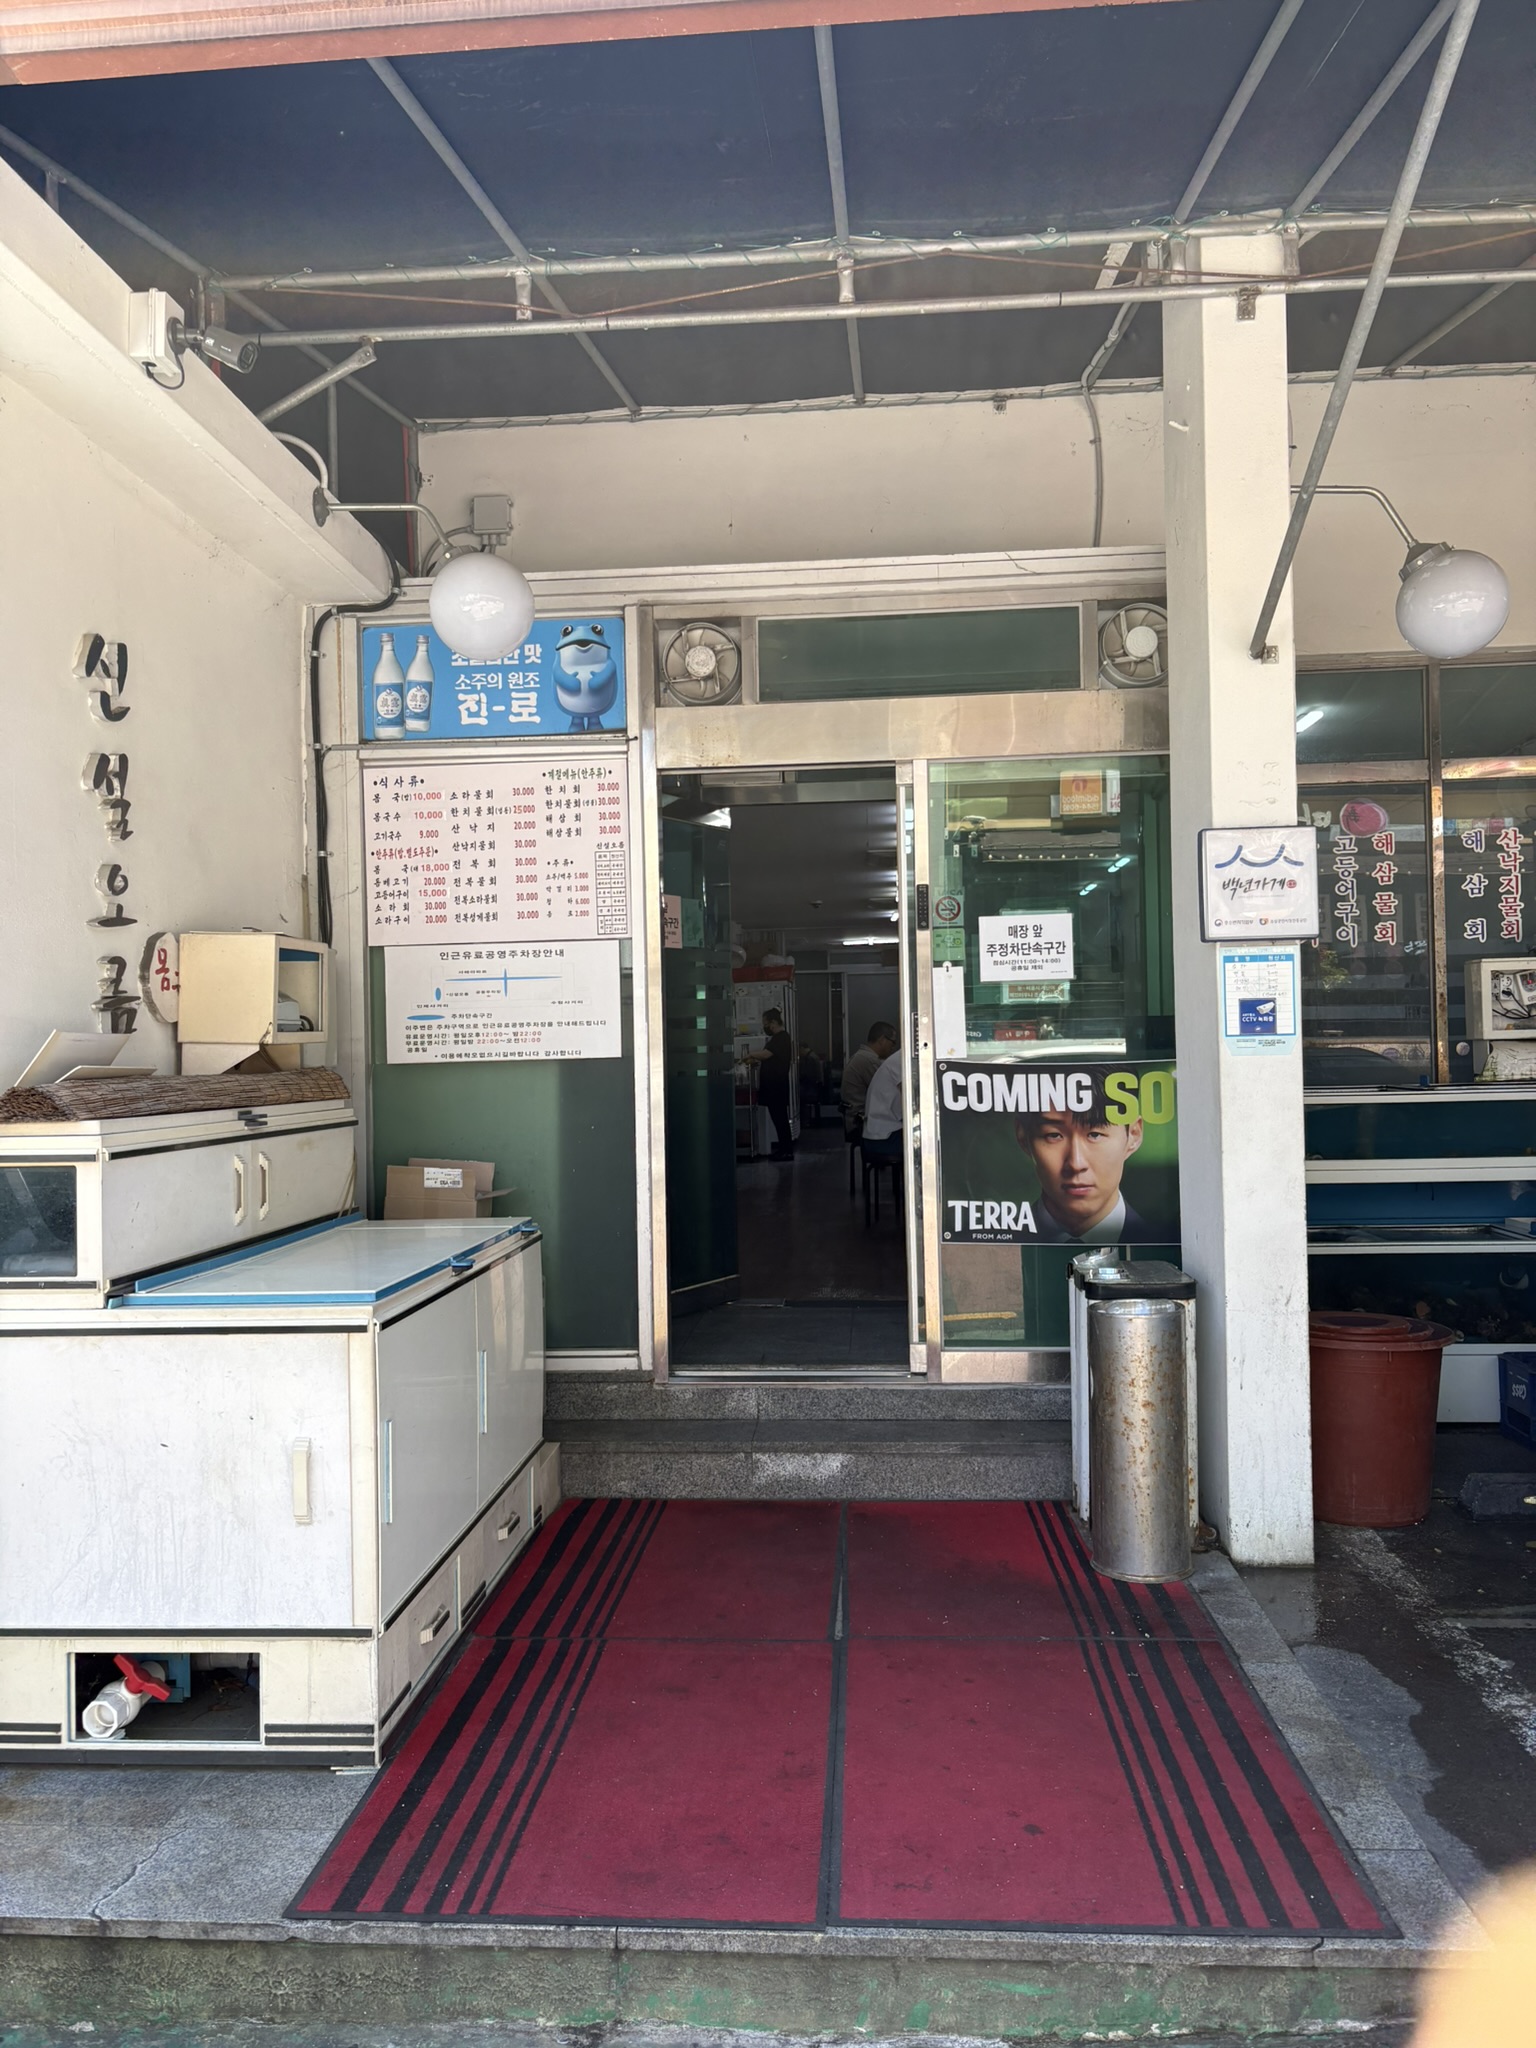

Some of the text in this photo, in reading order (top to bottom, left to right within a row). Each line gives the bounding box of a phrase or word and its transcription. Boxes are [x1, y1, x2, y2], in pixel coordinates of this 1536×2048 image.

[524, 644, 542, 664] 맛
[455, 672, 540, 690] 소주의 원조
[548, 767, 607, 780] 계절메뉴(안주류)
[512, 787, 534, 796] 30.000
[597, 782, 620, 791] 30.000
[413, 792, 442, 801] 10,000
[598, 797, 620, 806] 30.000
[414, 811, 443, 820] 10,000
[598, 811, 621, 820] 30.000
[514, 821, 536, 830] 20.000
[599, 825, 622, 835] 30.000
[80, 633, 141, 1034] 신설오름
[374, 830, 439, 841] 고기국수 9.000
[514, 840, 537, 848] 30.000
[515, 857, 537, 867] 30.000
[421, 864, 450, 872] 18,000
[424, 877, 446, 886] 20.000
[515, 875, 538, 884] 30.000
[1222, 877, 1286, 900] 백년가게
[1371, 831, 1398, 945] 해삼물회
[1462, 828, 1488, 942] 해삼회
[1497, 828, 1524, 942] 산낙지물회
[374, 889, 447, 900] 고등어구이 15,000
[1333, 835, 1360, 947] 고등어구이
[516, 892, 539, 902] 30.000
[425, 902, 447, 910] 30.000
[425, 915, 448, 924] 20.000
[517, 911, 539, 920] 30.000
[1008, 924, 1043, 939] 매장 앞
[986, 941, 1066, 957] 주정차단속구간
[439, 949, 565, 960] 인근유료공영주차장안내
[942, 1071, 1093, 1113] COMING
[948, 1200, 1037, 1234] TERRA
